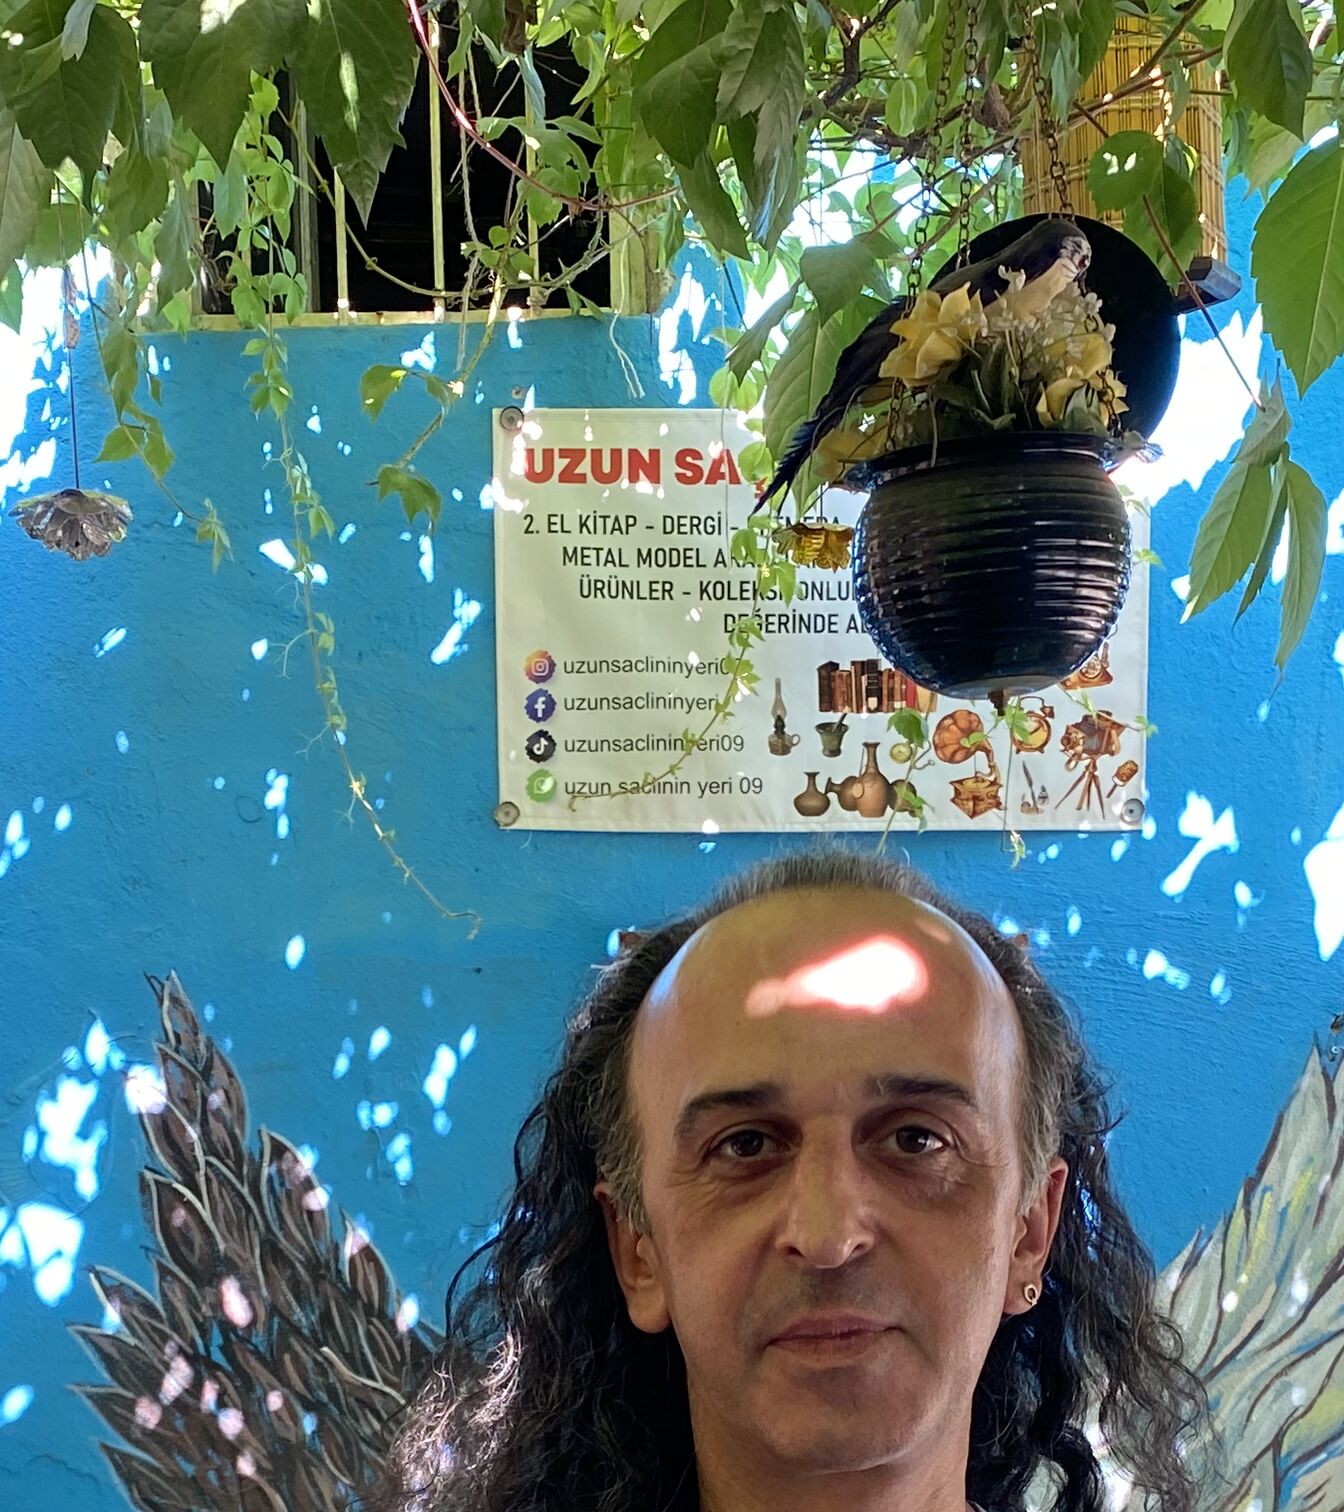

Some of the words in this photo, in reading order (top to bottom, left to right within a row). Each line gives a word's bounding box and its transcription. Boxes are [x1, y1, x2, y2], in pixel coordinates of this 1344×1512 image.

[523, 447, 661, 486] UZUN
[522, 514, 541, 535] 2.
[547, 513, 572, 534] EL
[578, 509, 638, 536] KİTAP
[662, 510, 723, 536] DERGİ
[561, 546, 630, 569] METAL
[636, 546, 707, 569] MODEL
[578, 573, 675, 601] ÜRÜNLER
[563, 656, 739, 678] uzunsaclininyeri0
[564, 733, 745, 754] uzunsaclinineri09
[564, 780, 611, 796] uzun
[697, 777, 733, 799] yeri
[739, 777, 764, 795] 09
